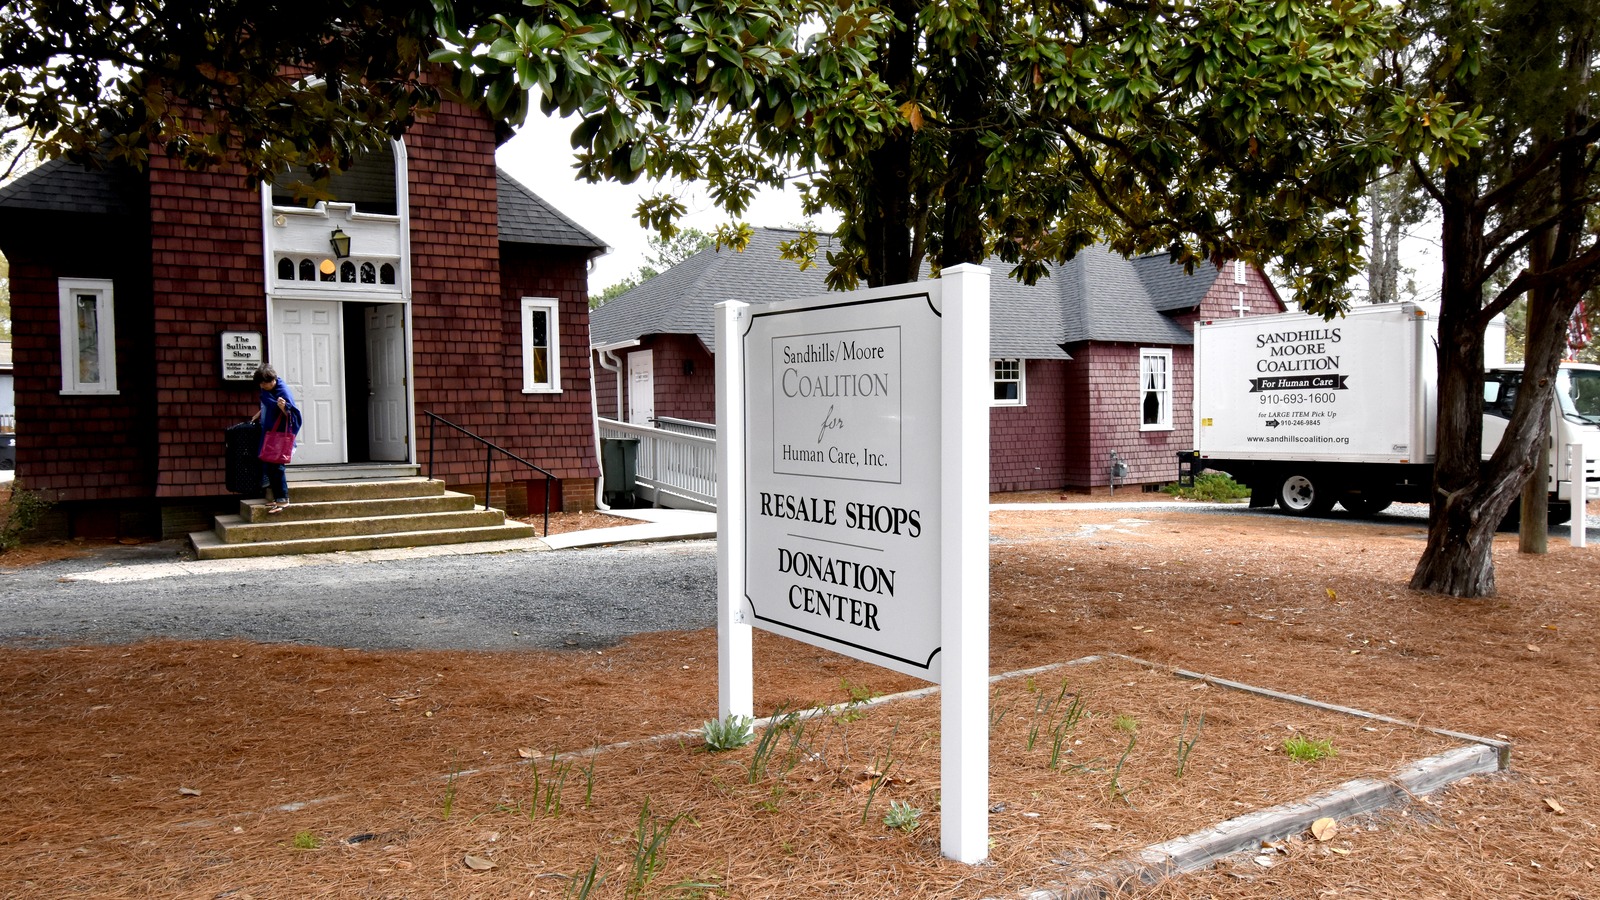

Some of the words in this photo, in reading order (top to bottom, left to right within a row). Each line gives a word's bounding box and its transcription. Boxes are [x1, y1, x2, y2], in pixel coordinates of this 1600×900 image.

[1256, 328, 1341, 348] SANDHILLS
[783, 341, 885, 364] Sandhills/Moore
[1270, 343, 1326, 357] MOORE
[1256, 356, 1340, 372] COALITION
[782, 368, 889, 398] COALITION
[1261, 379, 1276, 388] For
[1278, 378, 1310, 388] Human
[1312, 377, 1334, 386] Care
[1260, 392, 1336, 405] 910-693-1600
[817, 404, 844, 444] for
[1247, 435, 1350, 445] www.sandhillscoalition.org
[782, 444, 824, 463] Human
[828, 446, 860, 467] Care,
[864, 448, 888, 467] Inc.
[759, 492, 837, 526] RESALE
[845, 501, 921, 538] SHOPS
[777, 547, 896, 597] DONATION
[788, 584, 881, 632] CENTER
